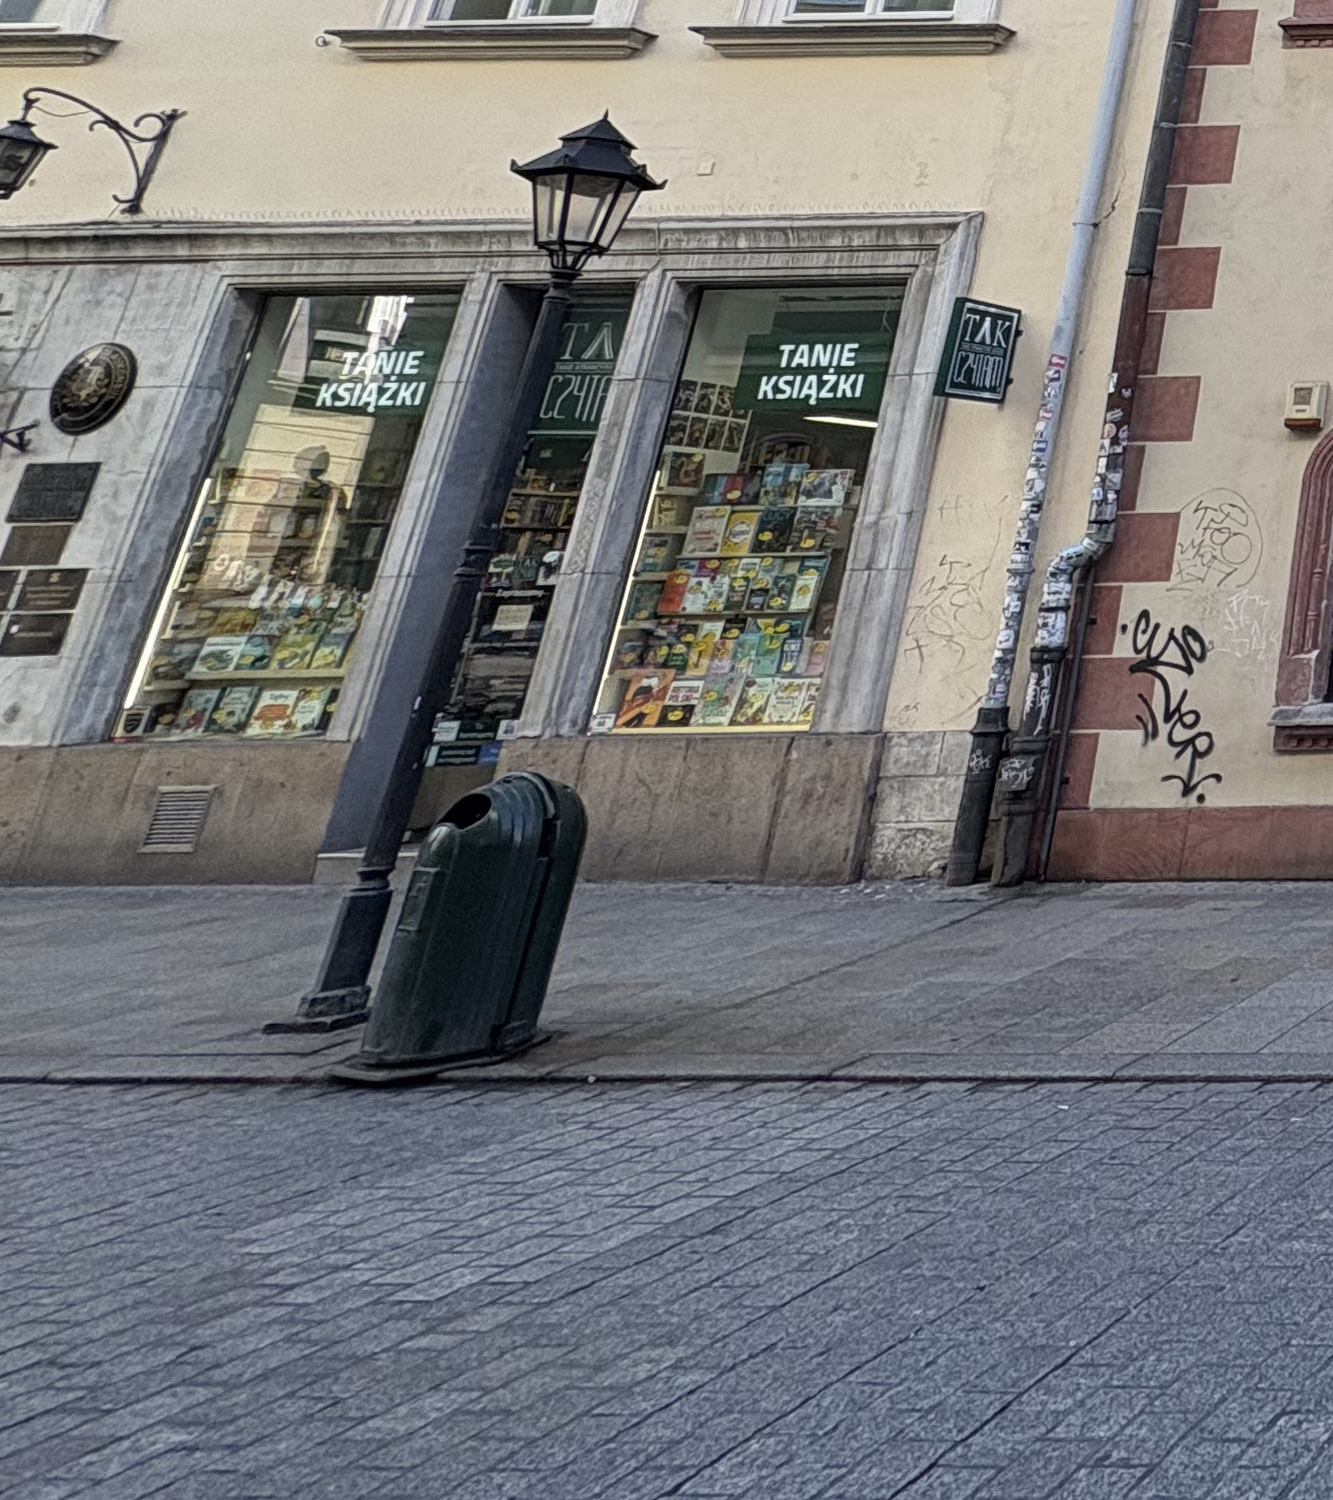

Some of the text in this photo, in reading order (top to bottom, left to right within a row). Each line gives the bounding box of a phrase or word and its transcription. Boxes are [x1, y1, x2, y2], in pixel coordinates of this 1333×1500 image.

[559, 321, 615, 360] TA
[963, 313, 1011, 348] TAK
[341, 350, 425, 376] TANIE
[779, 343, 859, 368] TANIE
[315, 375, 426, 414] KSIĄŻKI
[757, 367, 865, 406] KSIĄŻKI
